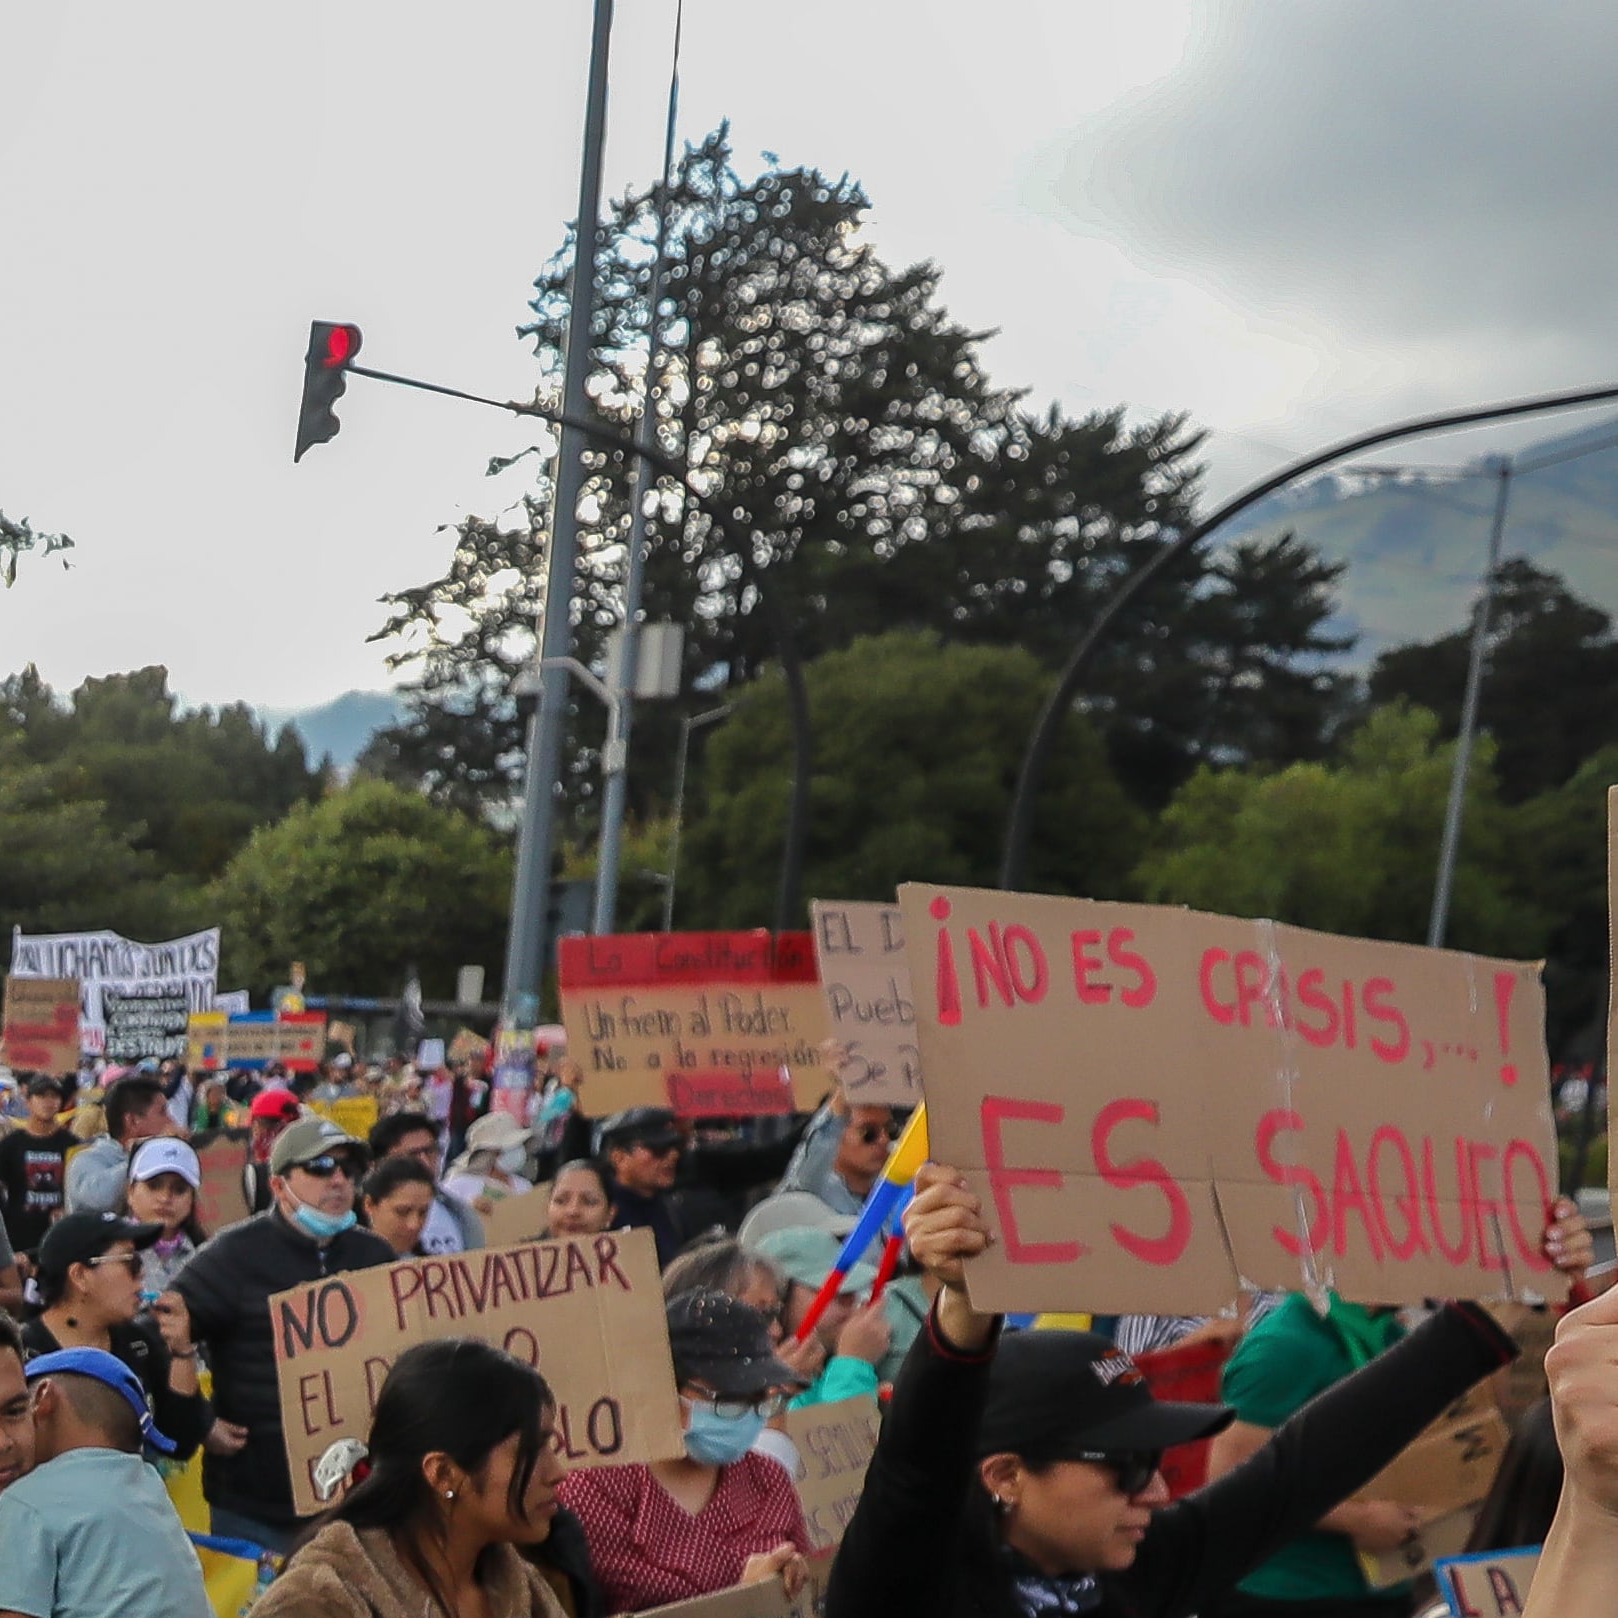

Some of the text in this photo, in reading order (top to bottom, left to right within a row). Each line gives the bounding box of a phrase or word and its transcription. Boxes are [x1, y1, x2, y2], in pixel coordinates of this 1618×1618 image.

[821, 911, 864, 953] EL
[1071, 928, 1158, 1009] ES
[981, 1095, 1555, 1273] ES SAQUEO
[280, 1237, 631, 1359] NO PRIVATIZAR
[299, 1369, 343, 1437] EL
